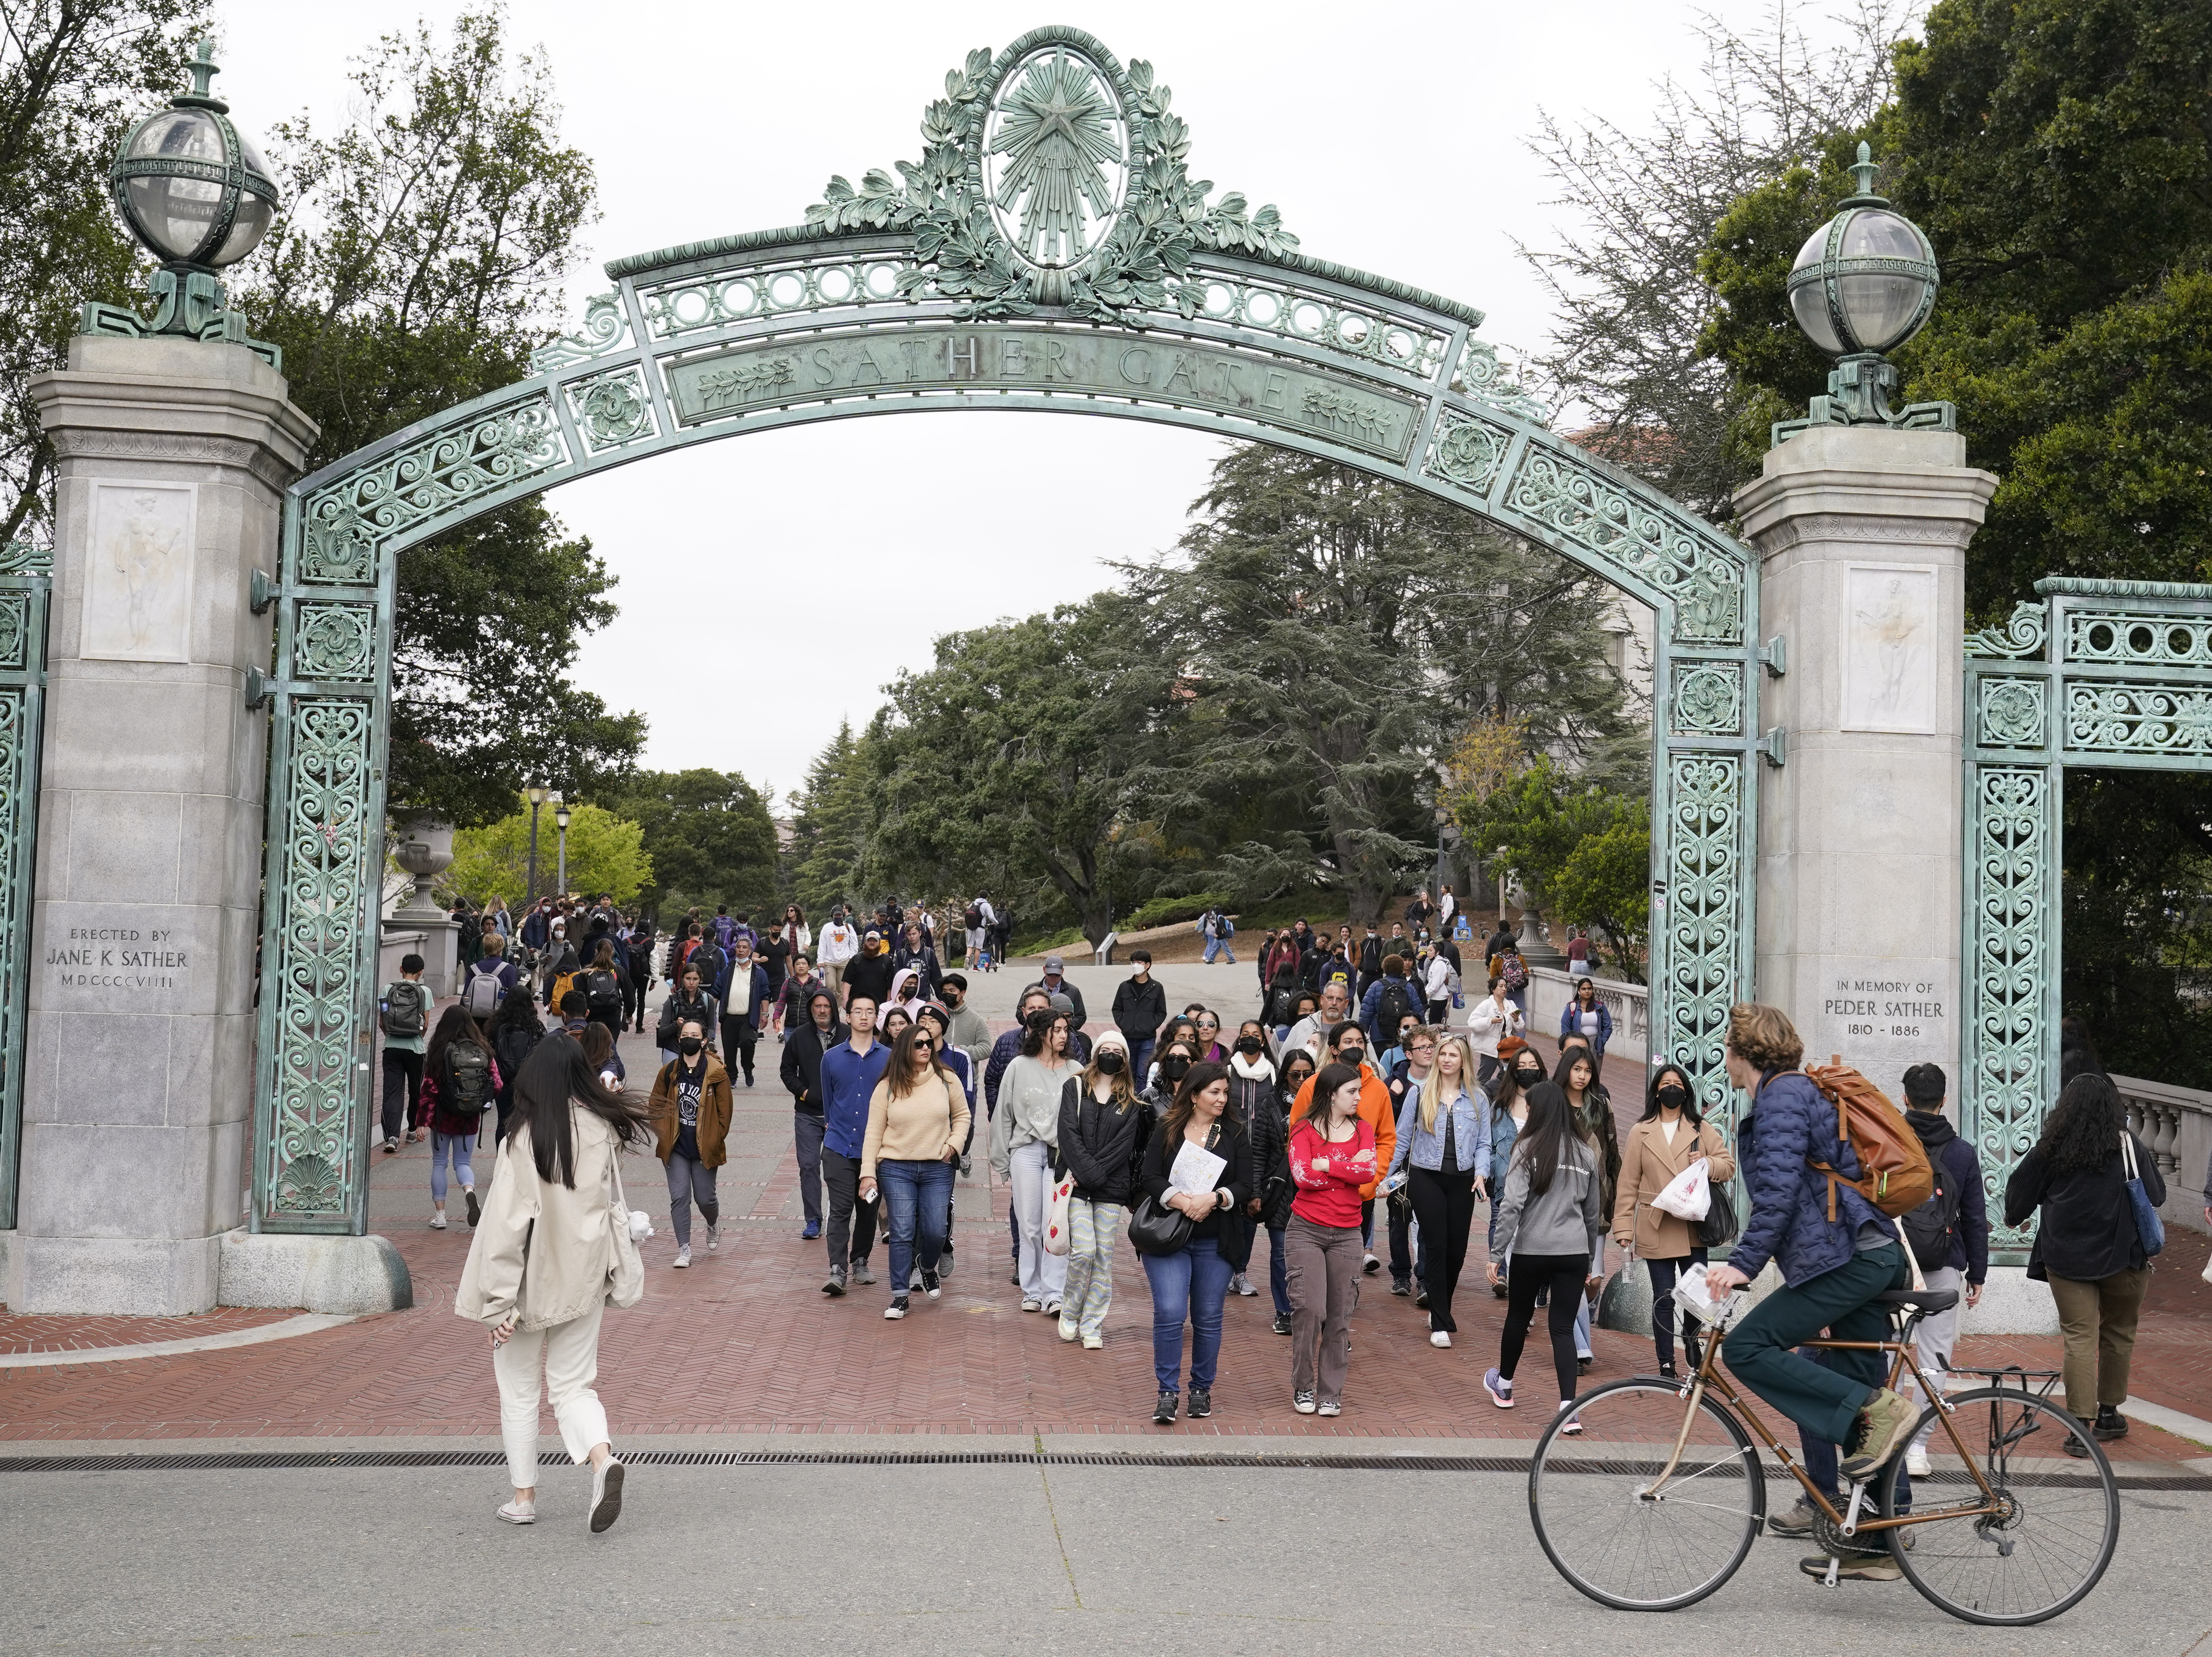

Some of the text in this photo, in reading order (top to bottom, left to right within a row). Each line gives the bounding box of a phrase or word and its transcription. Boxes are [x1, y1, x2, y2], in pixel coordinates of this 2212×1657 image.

[813, 337, 1287, 410] SATHER GATE
[70, 929, 171, 941] ERECTED BY
[47, 949, 189, 967] JANE K SATHER
[1837, 981, 1933, 993] IN MEMORY OF
[1825, 1000, 1944, 1018] PEDER SATHER
[1848, 1024, 1873, 1035] 1810
[1891, 1026, 1920, 1037] 1886
